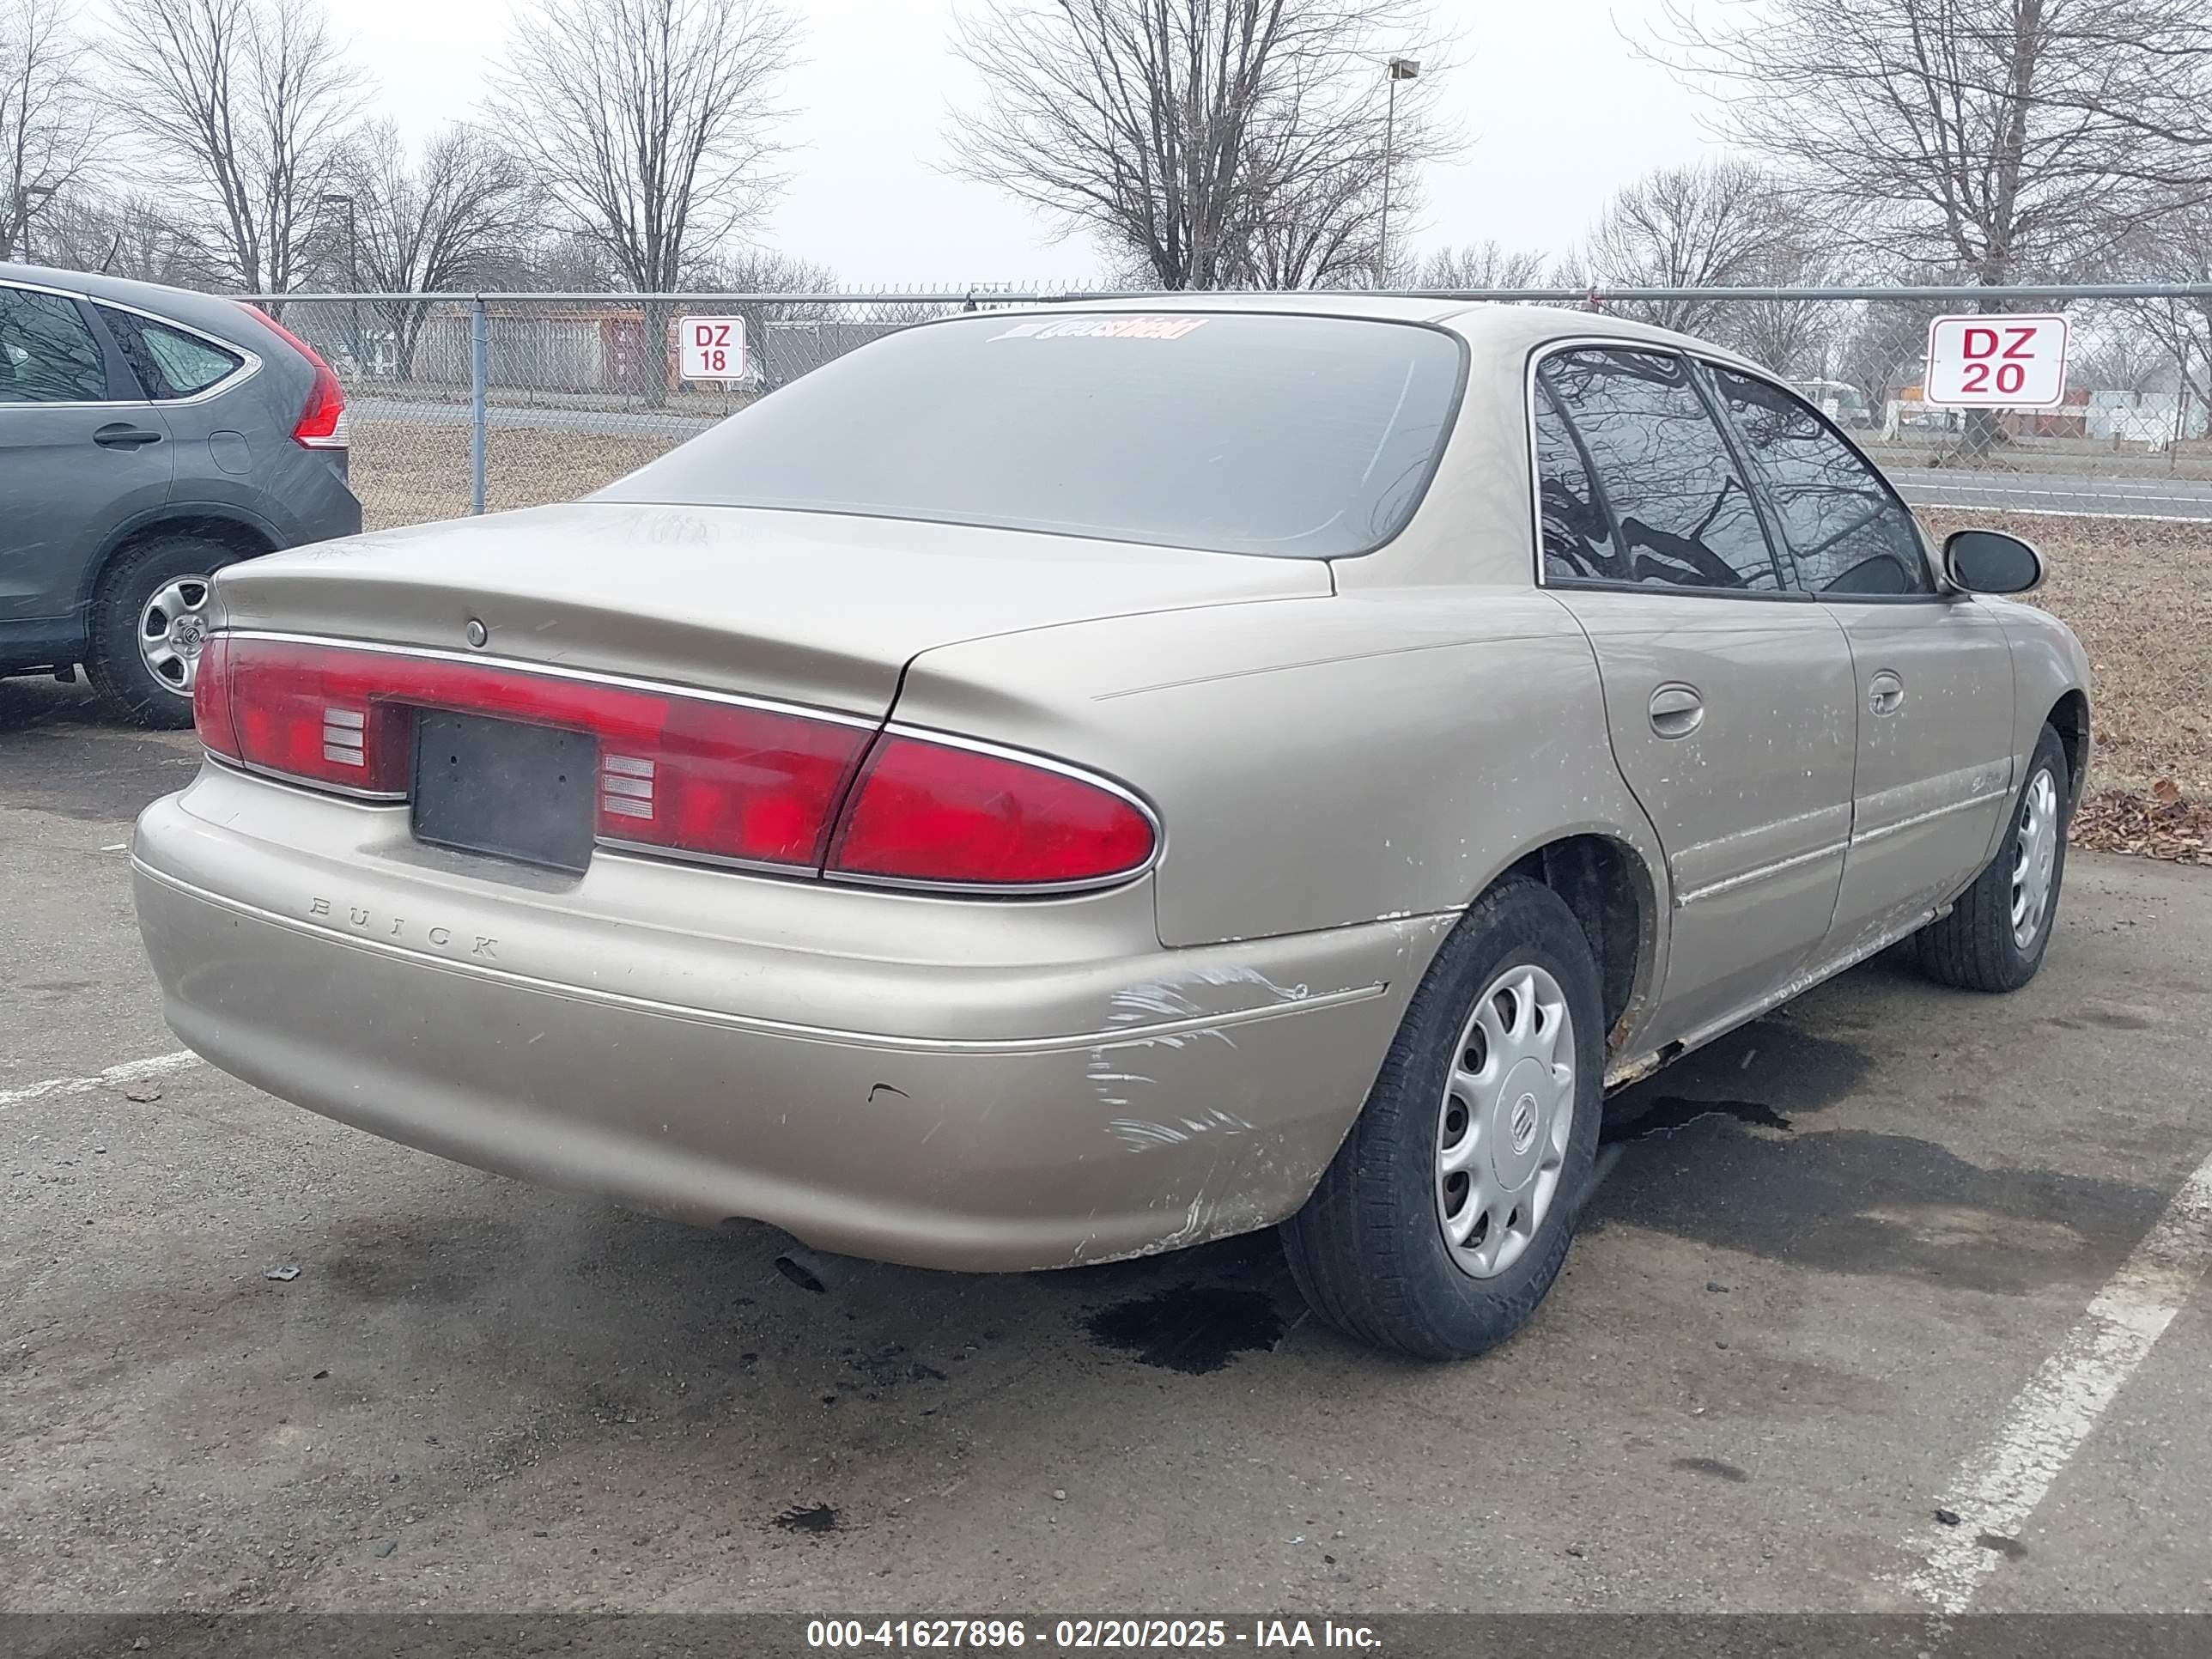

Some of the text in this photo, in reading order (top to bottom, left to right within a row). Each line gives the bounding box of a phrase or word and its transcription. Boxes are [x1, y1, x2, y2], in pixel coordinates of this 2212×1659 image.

[696, 325, 731, 347] DZ
[1963, 327, 2038, 359] DZ
[701, 349, 726, 371] 18
[1960, 363, 2026, 394] 20
[309, 896, 499, 959] BUICK
